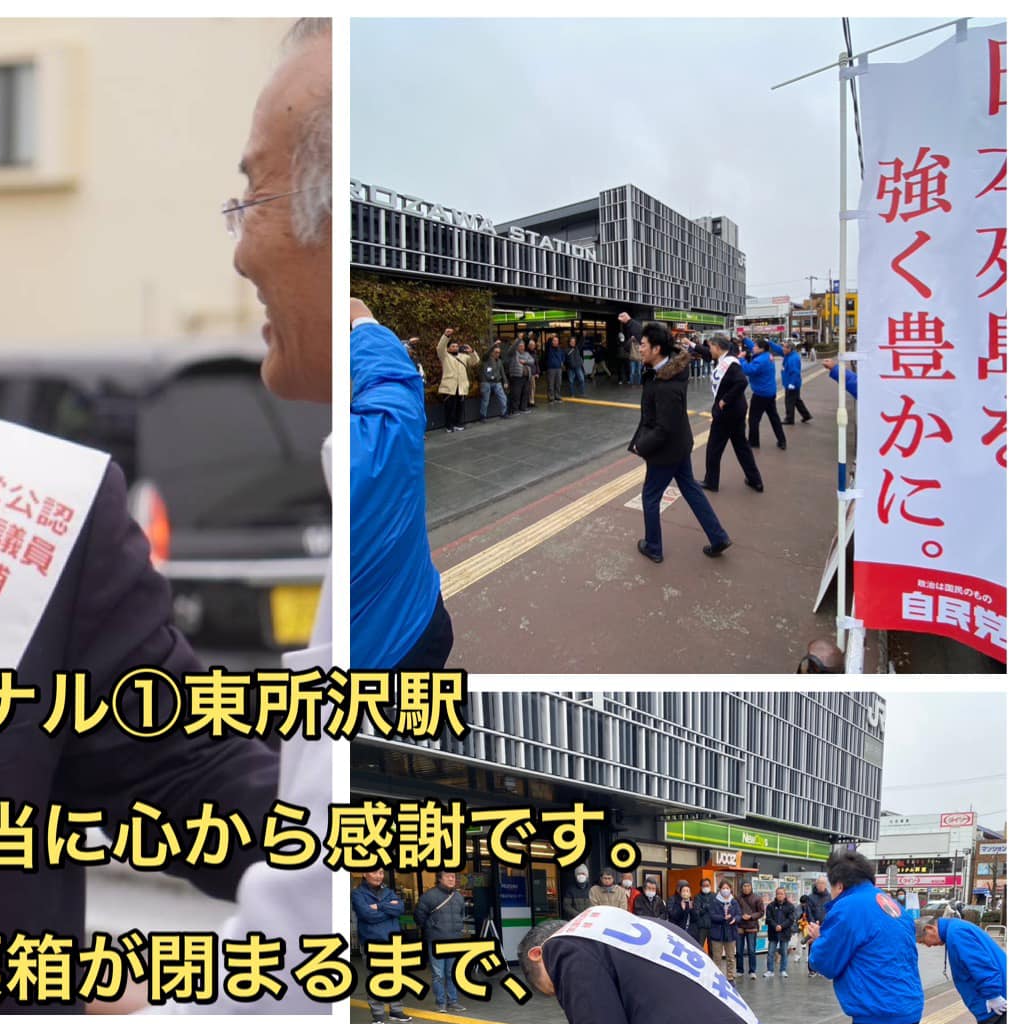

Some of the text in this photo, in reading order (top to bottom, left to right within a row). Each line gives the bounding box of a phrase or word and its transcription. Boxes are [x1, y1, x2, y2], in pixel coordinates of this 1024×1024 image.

[508, 226, 596, 261] STATION
[876, 147, 955, 558] 強く豊かに。
[902, 591, 1006, 650] 自民党
